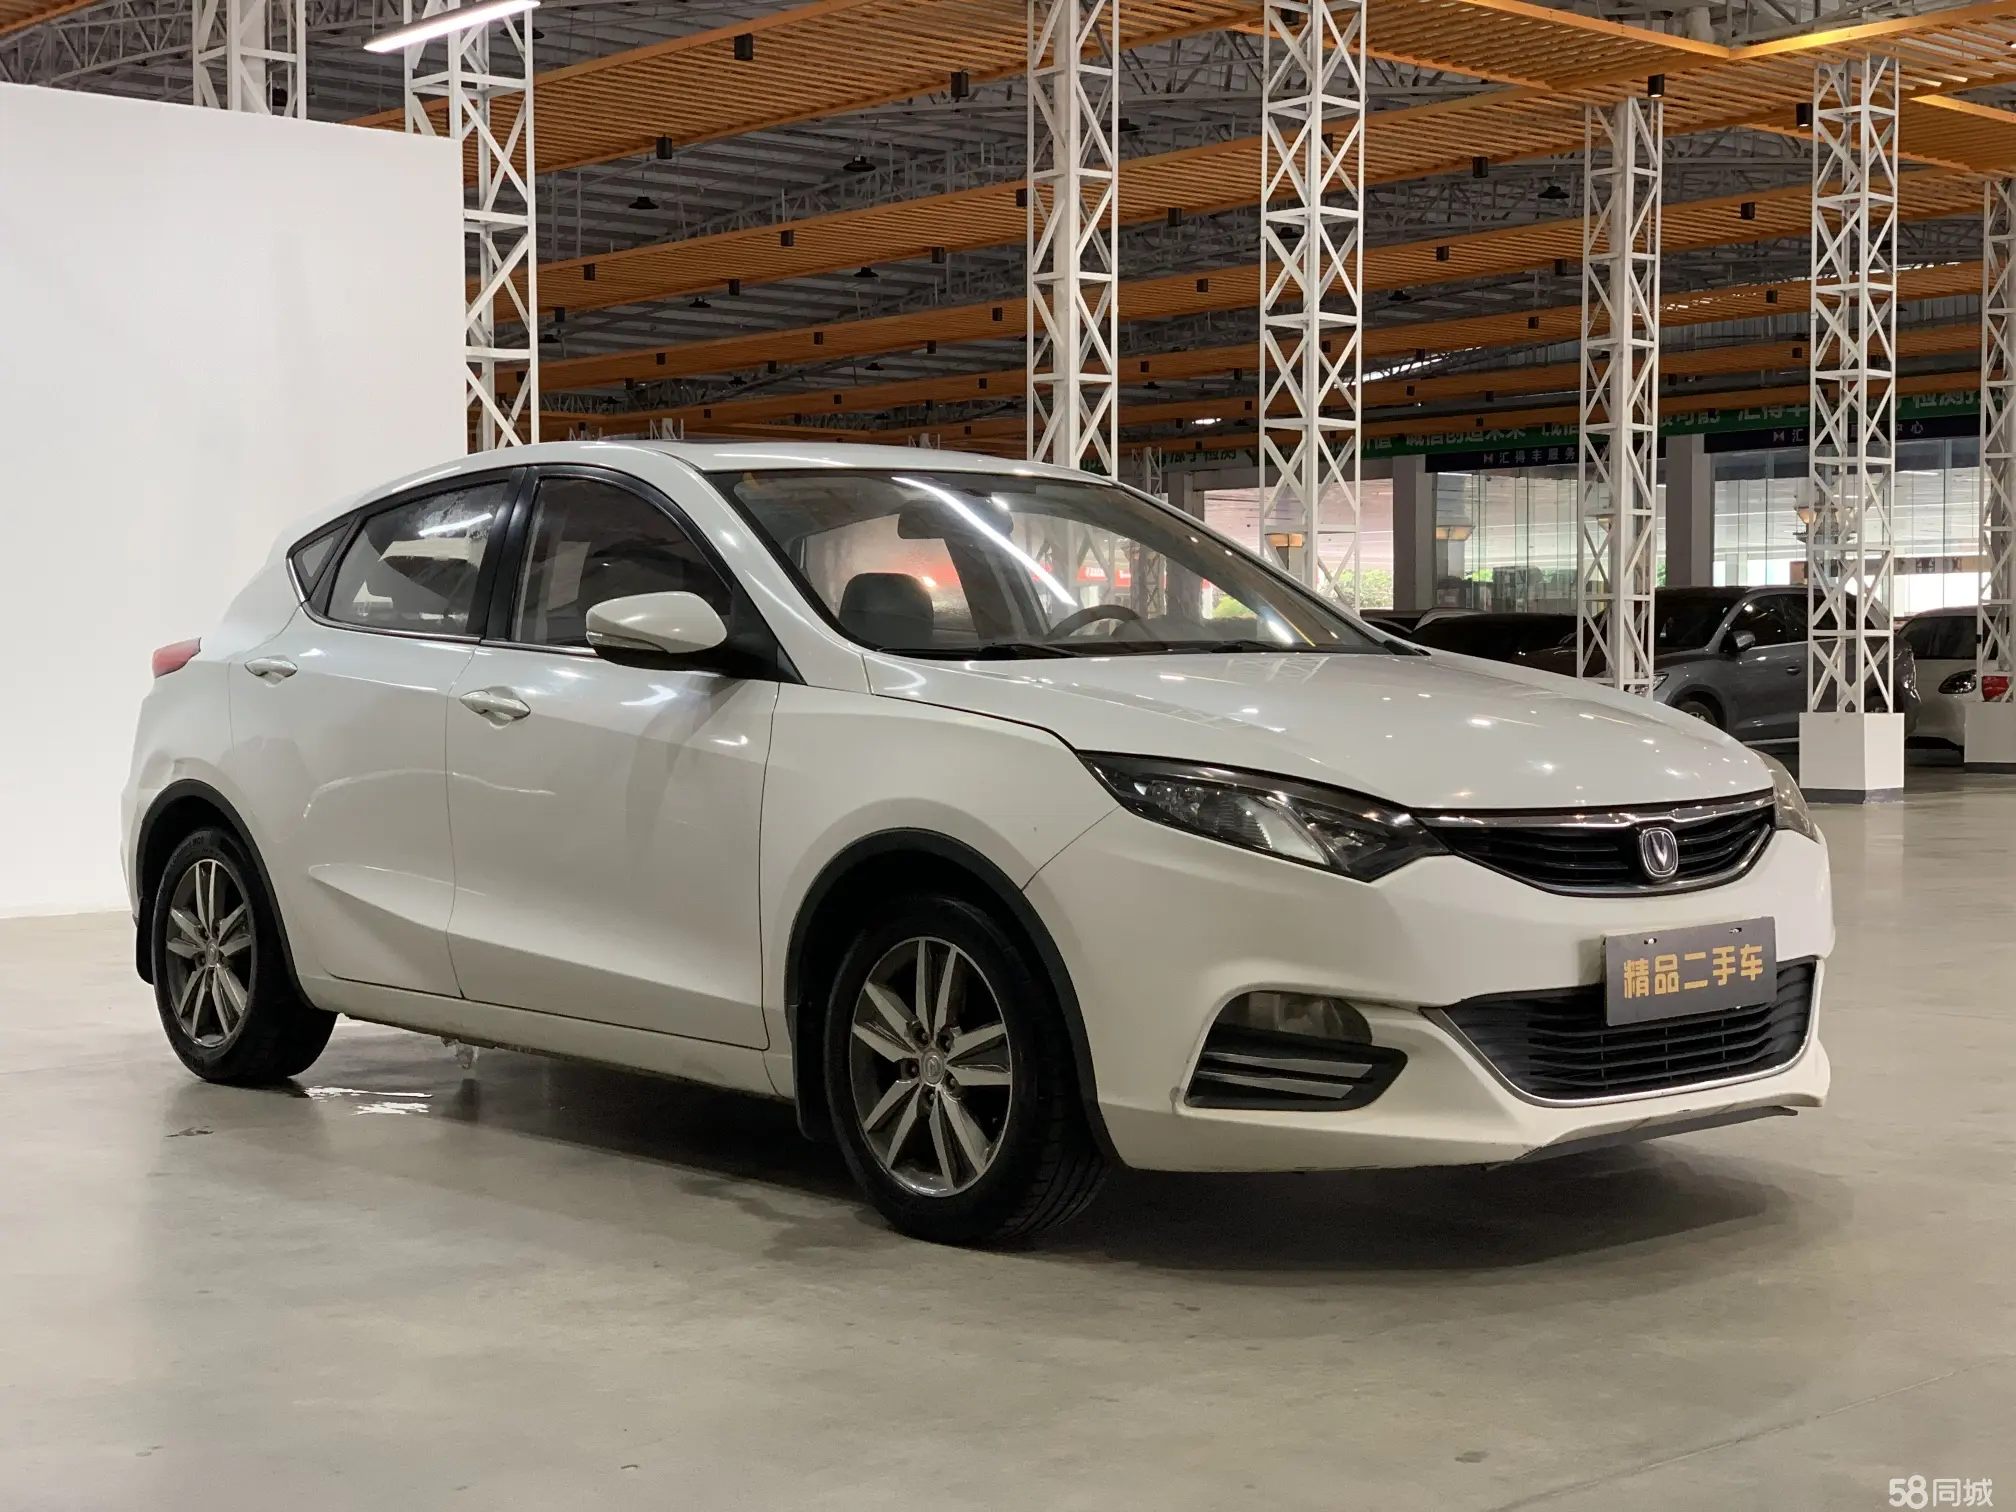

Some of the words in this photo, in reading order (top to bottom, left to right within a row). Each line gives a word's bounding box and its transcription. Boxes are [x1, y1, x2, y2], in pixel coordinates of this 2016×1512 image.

[1623, 943, 1764, 999] 精品二手车
